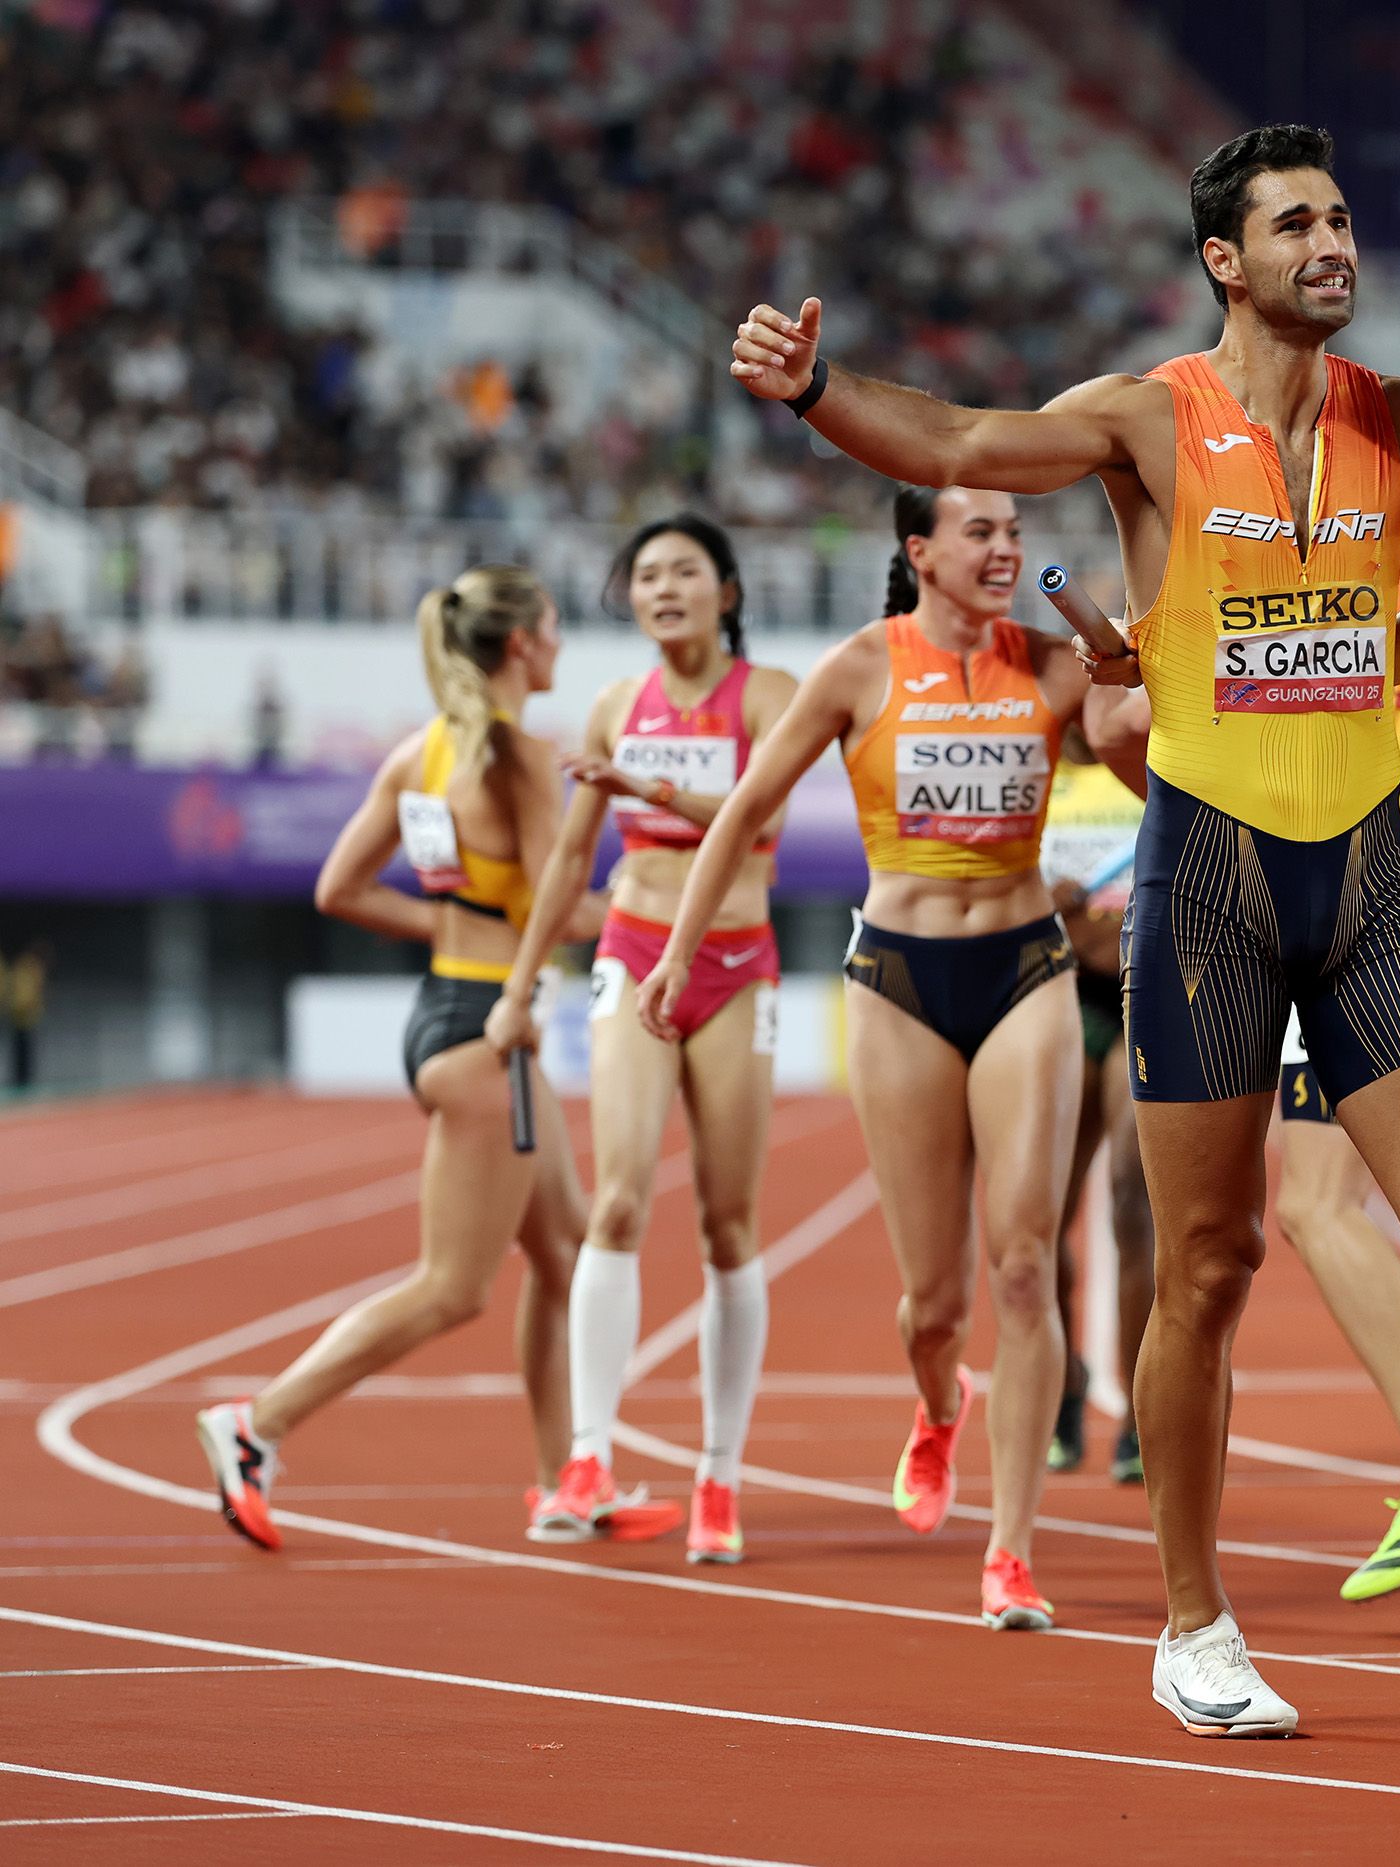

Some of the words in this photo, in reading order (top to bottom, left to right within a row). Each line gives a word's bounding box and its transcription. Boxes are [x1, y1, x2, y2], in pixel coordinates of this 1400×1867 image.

[1201, 507, 1385, 546] ESPAÑA
[1219, 586, 1380, 630] SEIKO
[1225, 643, 1255, 676] S.
[1264, 631, 1380, 677] GARCÍA
[901, 697, 1035, 721] ESPAÑA
[1266, 686, 1364, 702] GUANGZHOU
[1367, 685, 1380, 700] 25
[912, 742, 1035, 767] SONY
[908, 776, 1037, 812] AVILÉS
